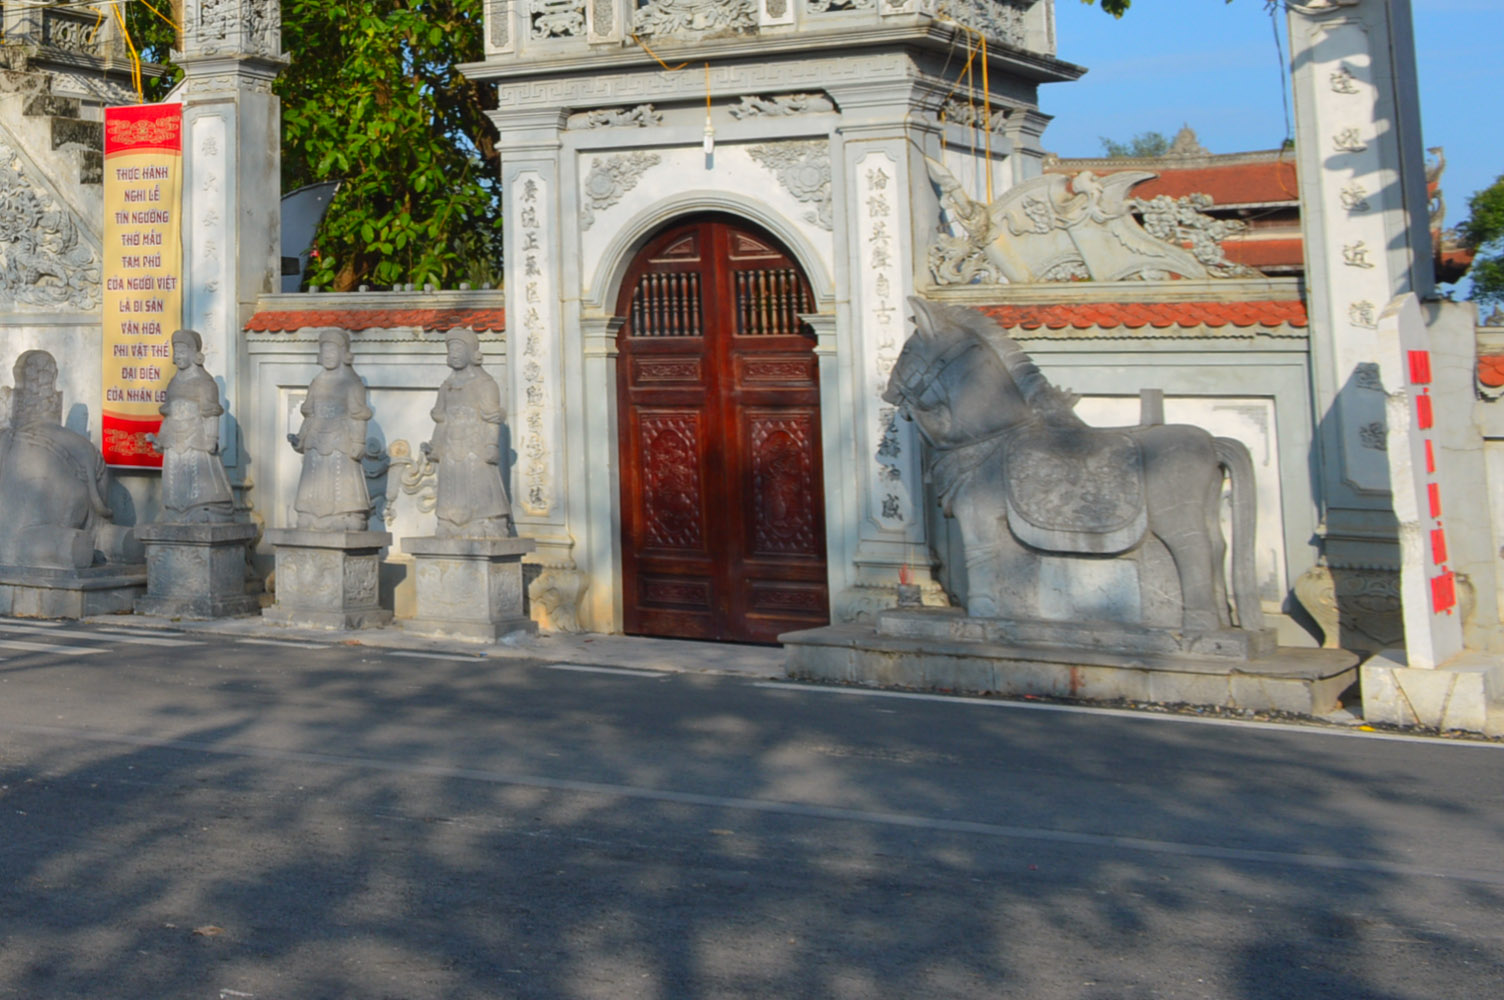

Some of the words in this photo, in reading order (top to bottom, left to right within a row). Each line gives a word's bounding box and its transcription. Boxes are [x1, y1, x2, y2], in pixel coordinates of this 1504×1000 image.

[116, 167, 140, 182] THỰC
[142, 165, 168, 180] HÀNH
[124, 190, 146, 202] NGHI
[149, 184, 160, 202] LỄ
[115, 209, 129, 224] TÍN
[132, 208, 169, 224] NGƯỠNG
[122, 256, 140, 268] TAM
[143, 252, 161, 268] PHỦ
[107, 275, 124, 290] CỦA
[127, 275, 154, 290] NGƯỜI
[157, 275, 177, 292] VIỆT
[119, 297, 131, 312] LÀ
[145, 296, 163, 312] SẢN
[113, 345, 128, 357] PHI
[131, 342, 148, 359] VẬT
[151, 340, 169, 358] THỂ
[121, 366, 137, 382] ĐẠI
[139, 365, 160, 382] DIỆN
[106, 385, 124, 401] CỦA
[127, 386, 152, 402] NHÂN
